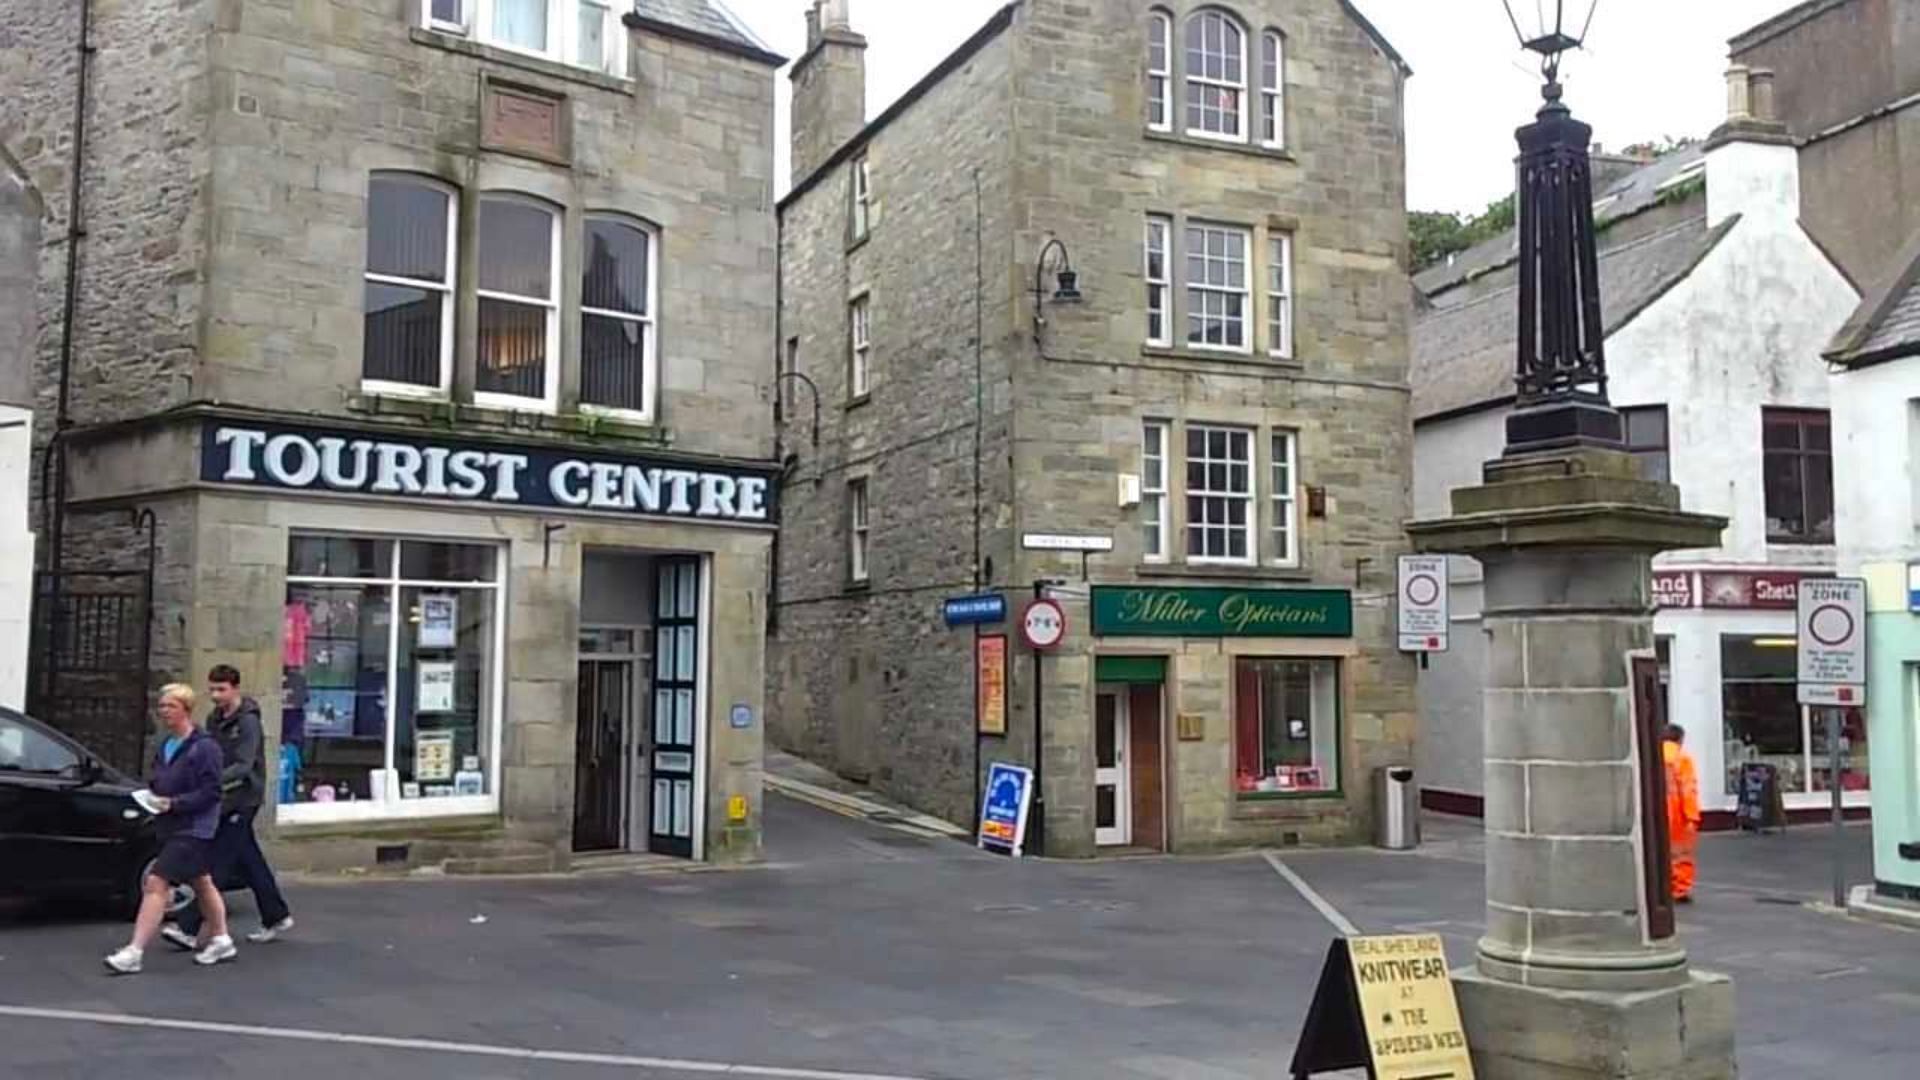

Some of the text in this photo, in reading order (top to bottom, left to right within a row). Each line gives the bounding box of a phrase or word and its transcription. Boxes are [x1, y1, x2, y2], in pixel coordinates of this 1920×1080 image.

[216, 428, 767, 519] TOURIST CENTRE
[1811, 589, 1851, 601] ZONE
[1117, 589, 1327, 632] Miller Opticians
[1358, 957, 1446, 984] KNITWEAR
[1401, 985, 1414, 999] AT
[1401, 1007, 1429, 1026] THE
